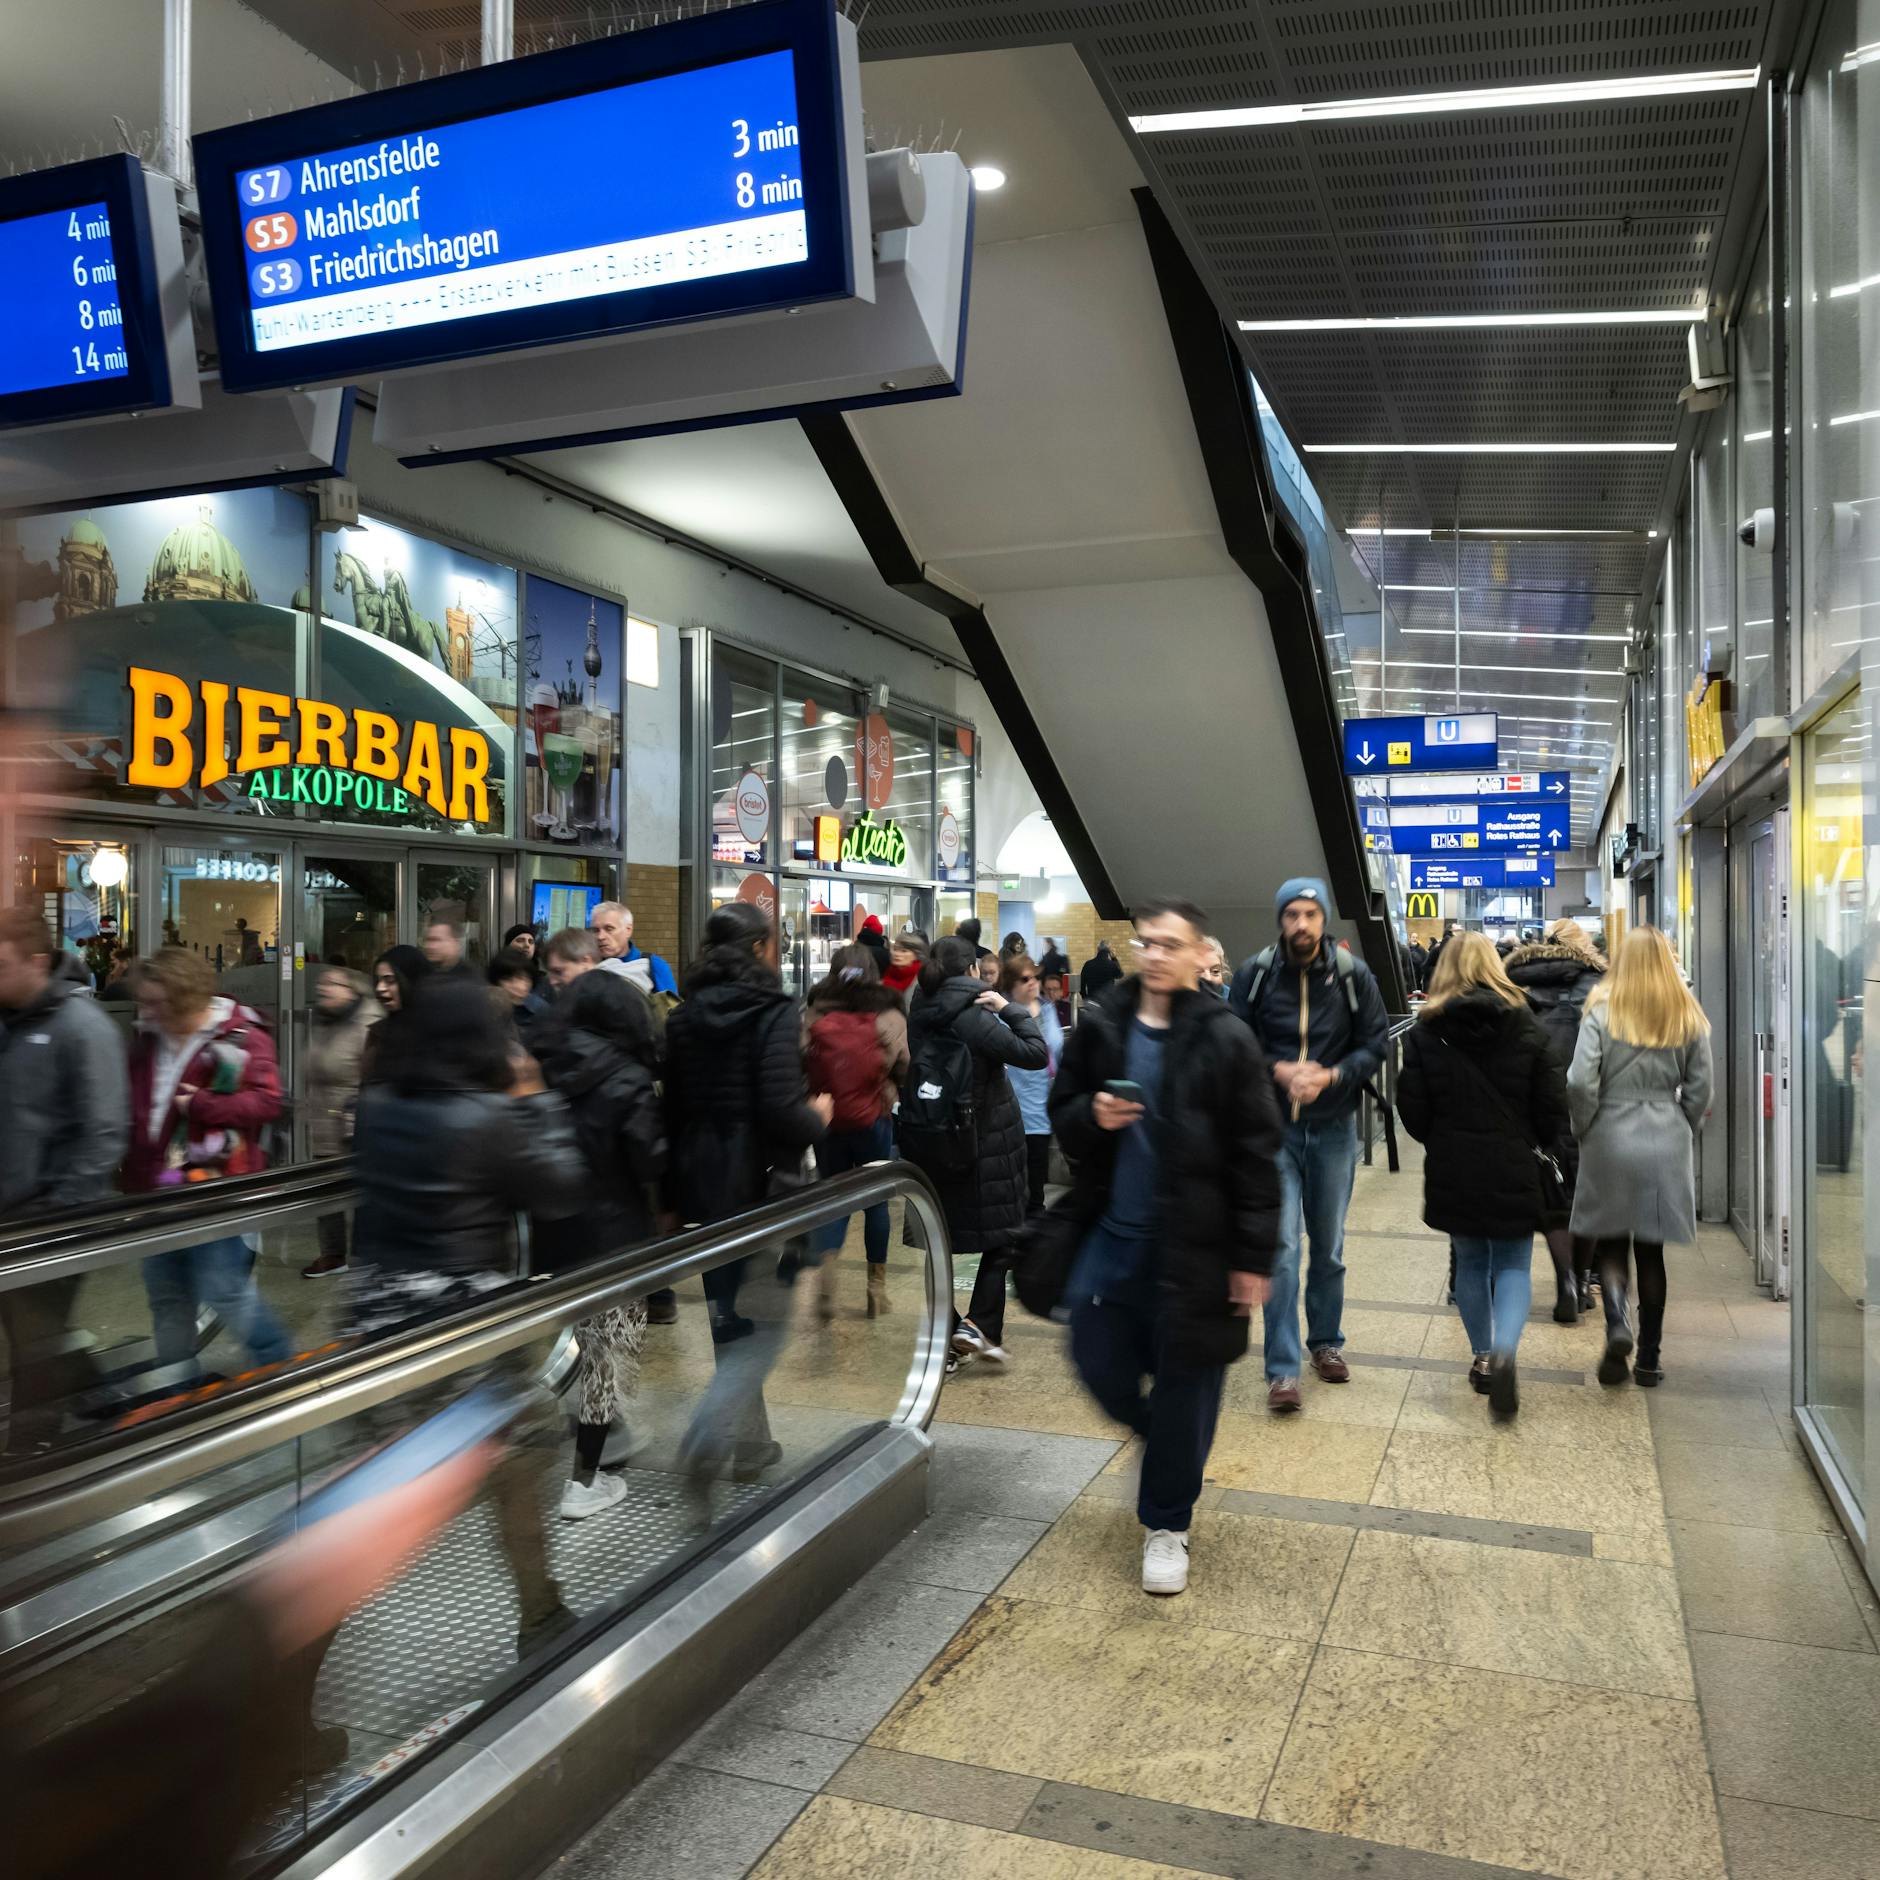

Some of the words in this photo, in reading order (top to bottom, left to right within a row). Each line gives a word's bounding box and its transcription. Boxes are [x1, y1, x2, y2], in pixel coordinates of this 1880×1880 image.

[249, 169, 281, 202] S7
[300, 136, 440, 195] Ahrensfelde
[254, 216, 288, 248] S5
[304, 185, 421, 241] Mahlsdorf
[732, 119, 750, 158] 3
[758, 121, 799, 152] min
[67, 211, 82, 242] 4
[260, 262, 294, 294] S3
[309, 228, 499, 288] Friedrichshagen
[736, 172, 756, 208] 8
[762, 174, 803, 205] min
[72, 255, 88, 287] 6
[79, 299, 94, 330] 8
[71, 342, 100, 375] 14
[127, 667, 490, 823] BIERBAR
[1440, 721, 1457, 741] U
[248, 767, 410, 814] ALKOPOLE
[1449, 809, 1461, 822] U
[1507, 812, 1541, 821] Ausgang
